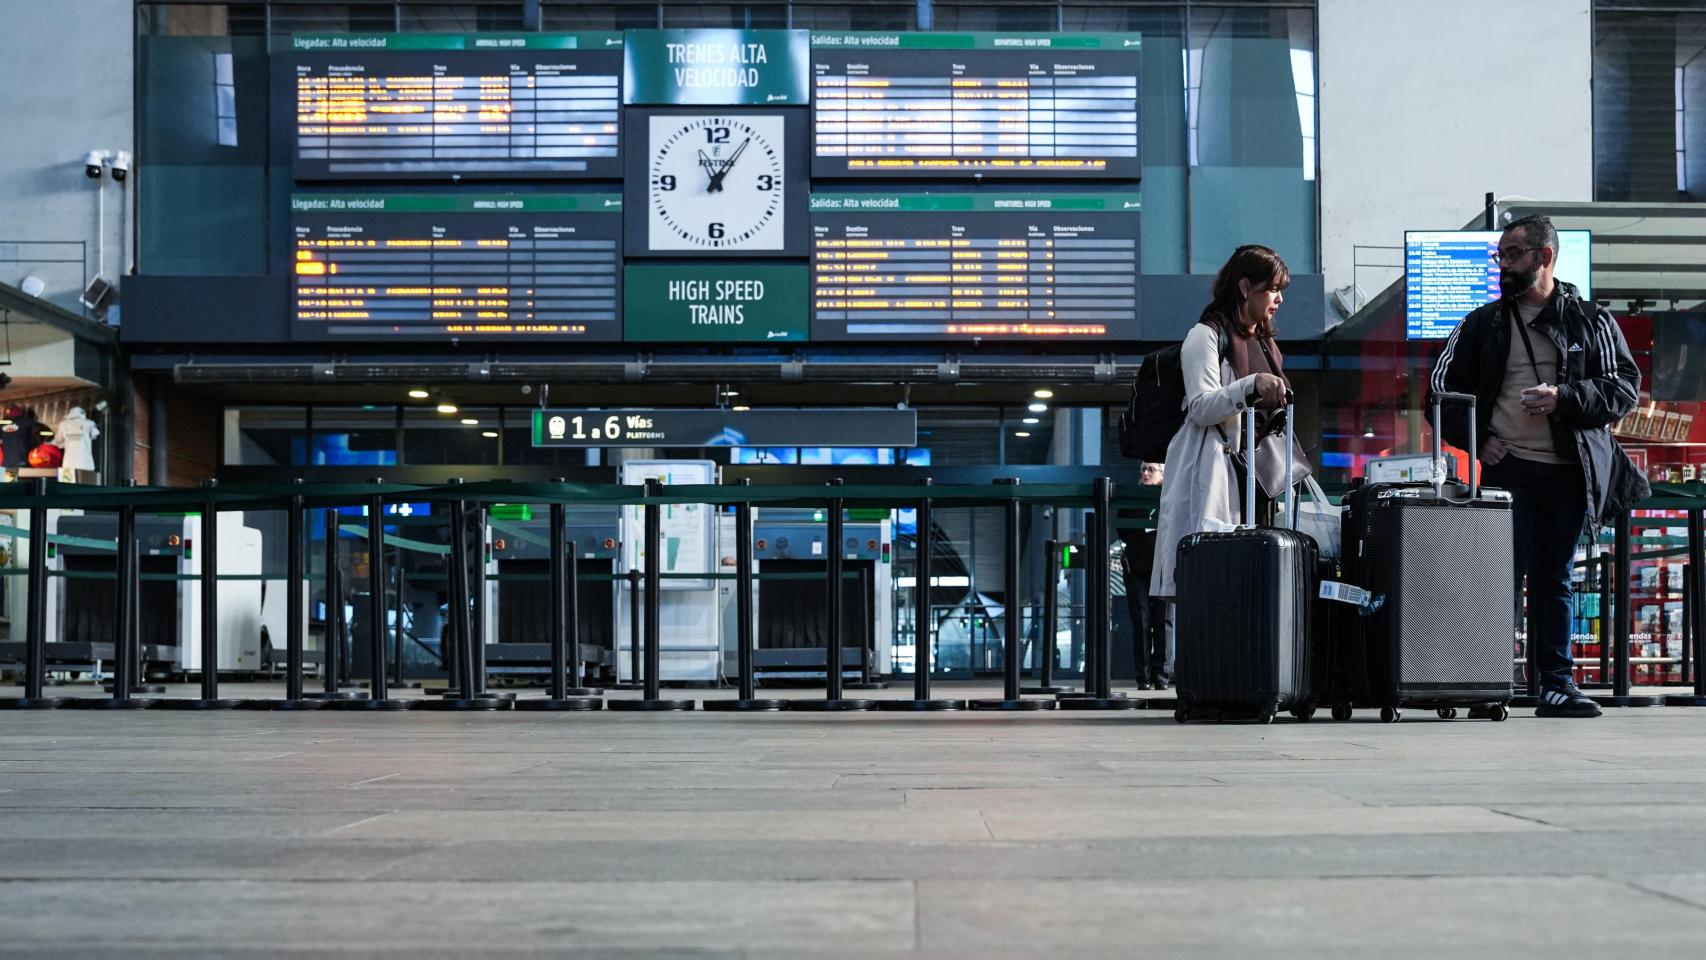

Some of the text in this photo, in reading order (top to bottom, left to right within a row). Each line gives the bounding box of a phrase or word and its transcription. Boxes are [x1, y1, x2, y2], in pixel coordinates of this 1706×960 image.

[294, 37, 387, 49] Llegadas: Alta velocidad
[499, 39, 511, 47] HIGH
[511, 39, 526, 47] SPEED
[811, 36, 900, 45] Salidas: Alta velocidad
[1024, 38, 1037, 47] HIGH
[1037, 38, 1051, 47] SPEED
[666, 43, 768, 64] TRENES ALTA
[674, 68, 759, 88] VELOCIDAD
[704, 127, 730, 144] 12
[660, 175, 677, 191] 9
[756, 175, 773, 191] 3
[292, 199, 384, 211] Llegadas: Alta velocidad
[497, 200, 509, 209] HIGH
[509, 200, 523, 209] SPEED
[810, 198, 899, 208] Salidas: Alta velocidad
[1024, 200, 1036, 208] HIGH
[1036, 200, 1051, 208] SPEED
[708, 222, 725, 239] 6
[669, 280, 764, 301] HIGH SPEED
[689, 304, 745, 325] TRAINS
[572, 415, 653, 439] 1 a 6 Vías
[626, 431, 665, 439] PLATFORMS
[1629, 632, 1652, 640] endas
